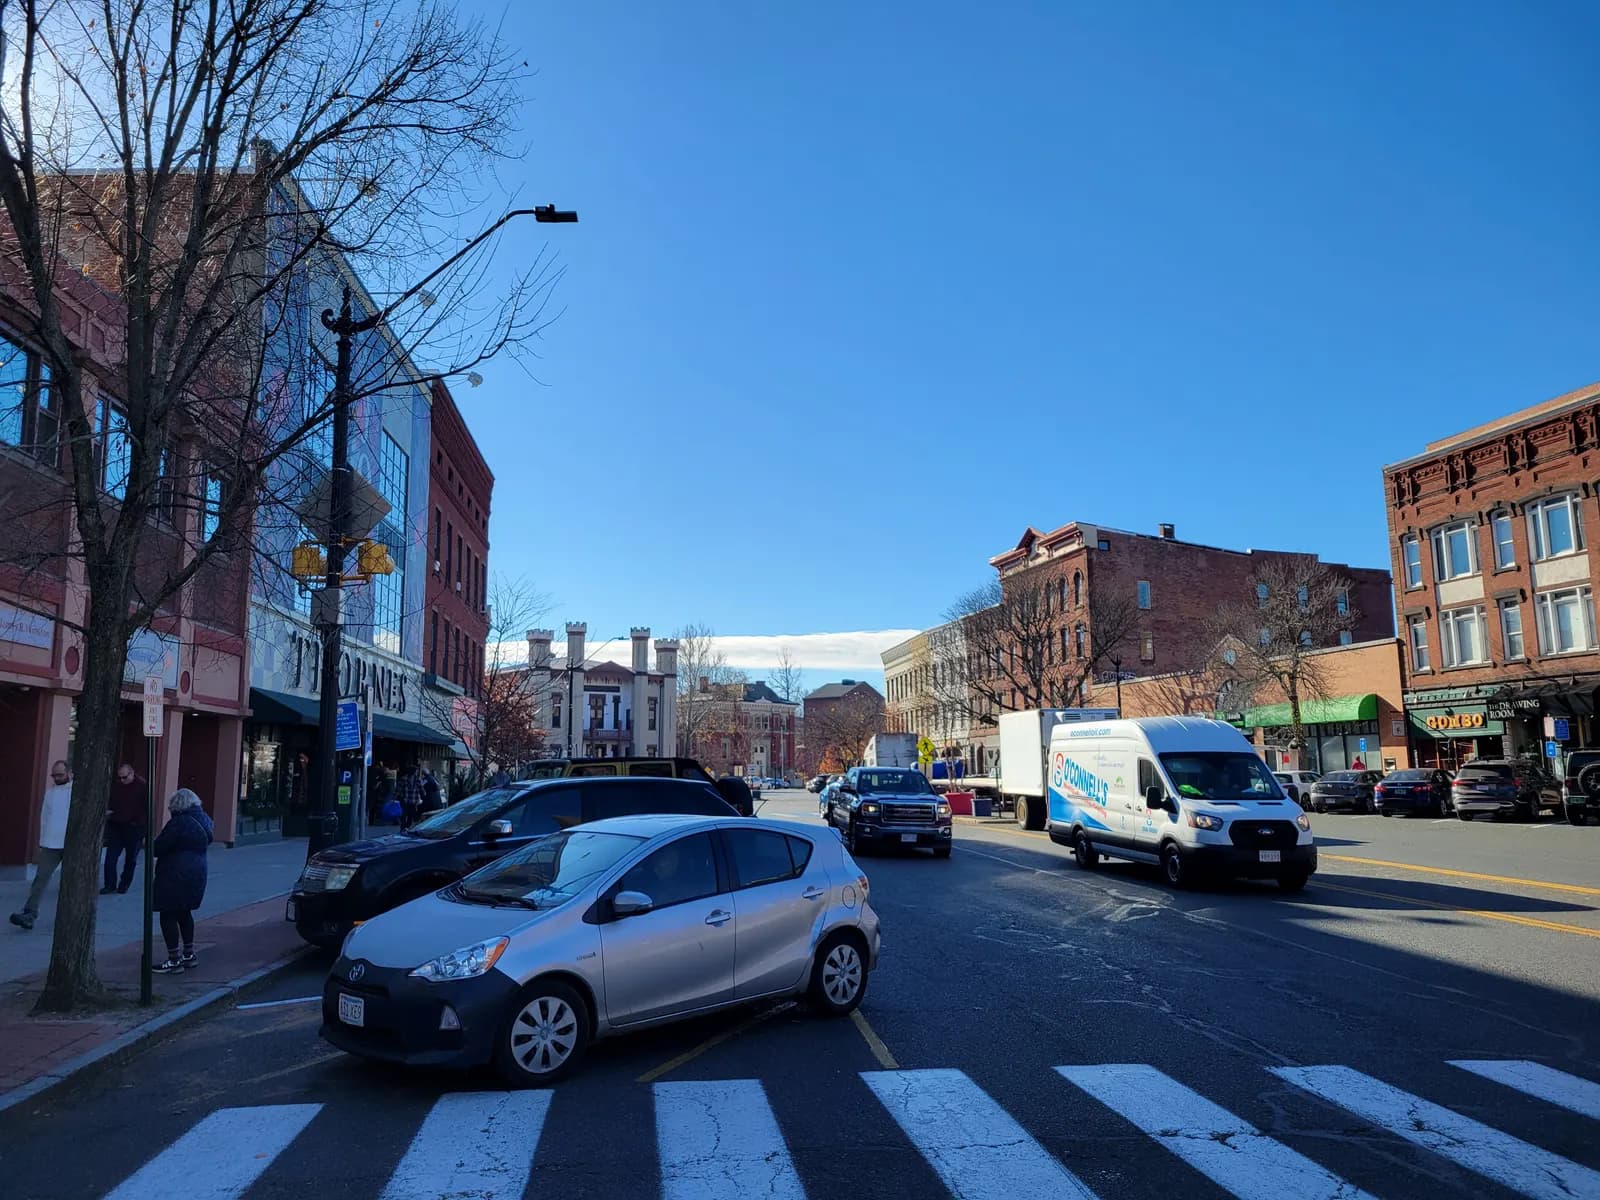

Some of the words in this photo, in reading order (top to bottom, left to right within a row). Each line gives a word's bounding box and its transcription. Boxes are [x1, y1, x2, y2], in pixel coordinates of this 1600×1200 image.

[1499, 699, 1540, 710] DRAWING
[1426, 713, 1483, 729] GOMBO
[1489, 710, 1515, 719] ROOM
[343, 770, 352, 784] P
[1064, 758, 1109, 807] O'CONNELL'S
